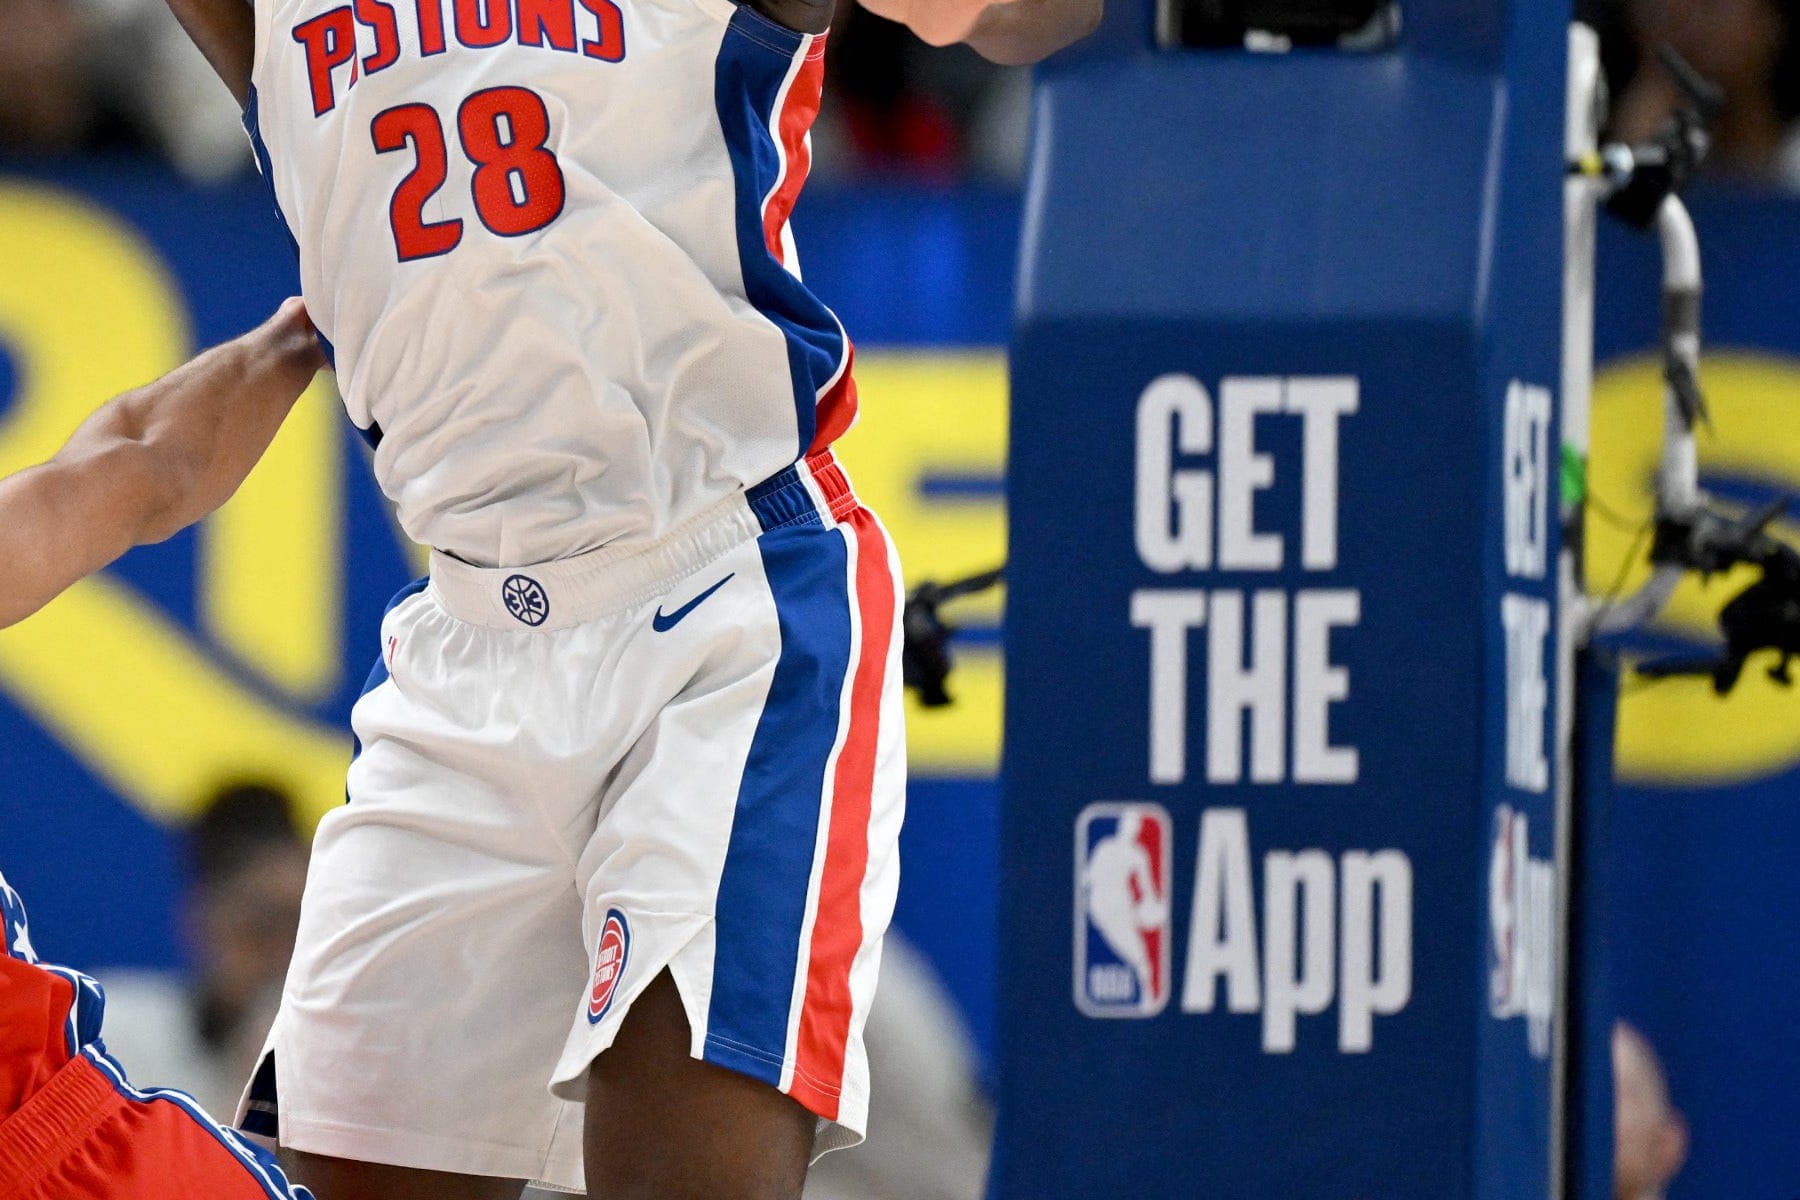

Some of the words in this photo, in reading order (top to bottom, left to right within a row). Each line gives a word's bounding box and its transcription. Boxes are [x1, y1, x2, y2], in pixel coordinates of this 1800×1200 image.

[370, 85, 566, 263] 28
[1134, 372, 1360, 574] GET
[1130, 589, 1360, 785] THE
[1181, 807, 1413, 1053] App
